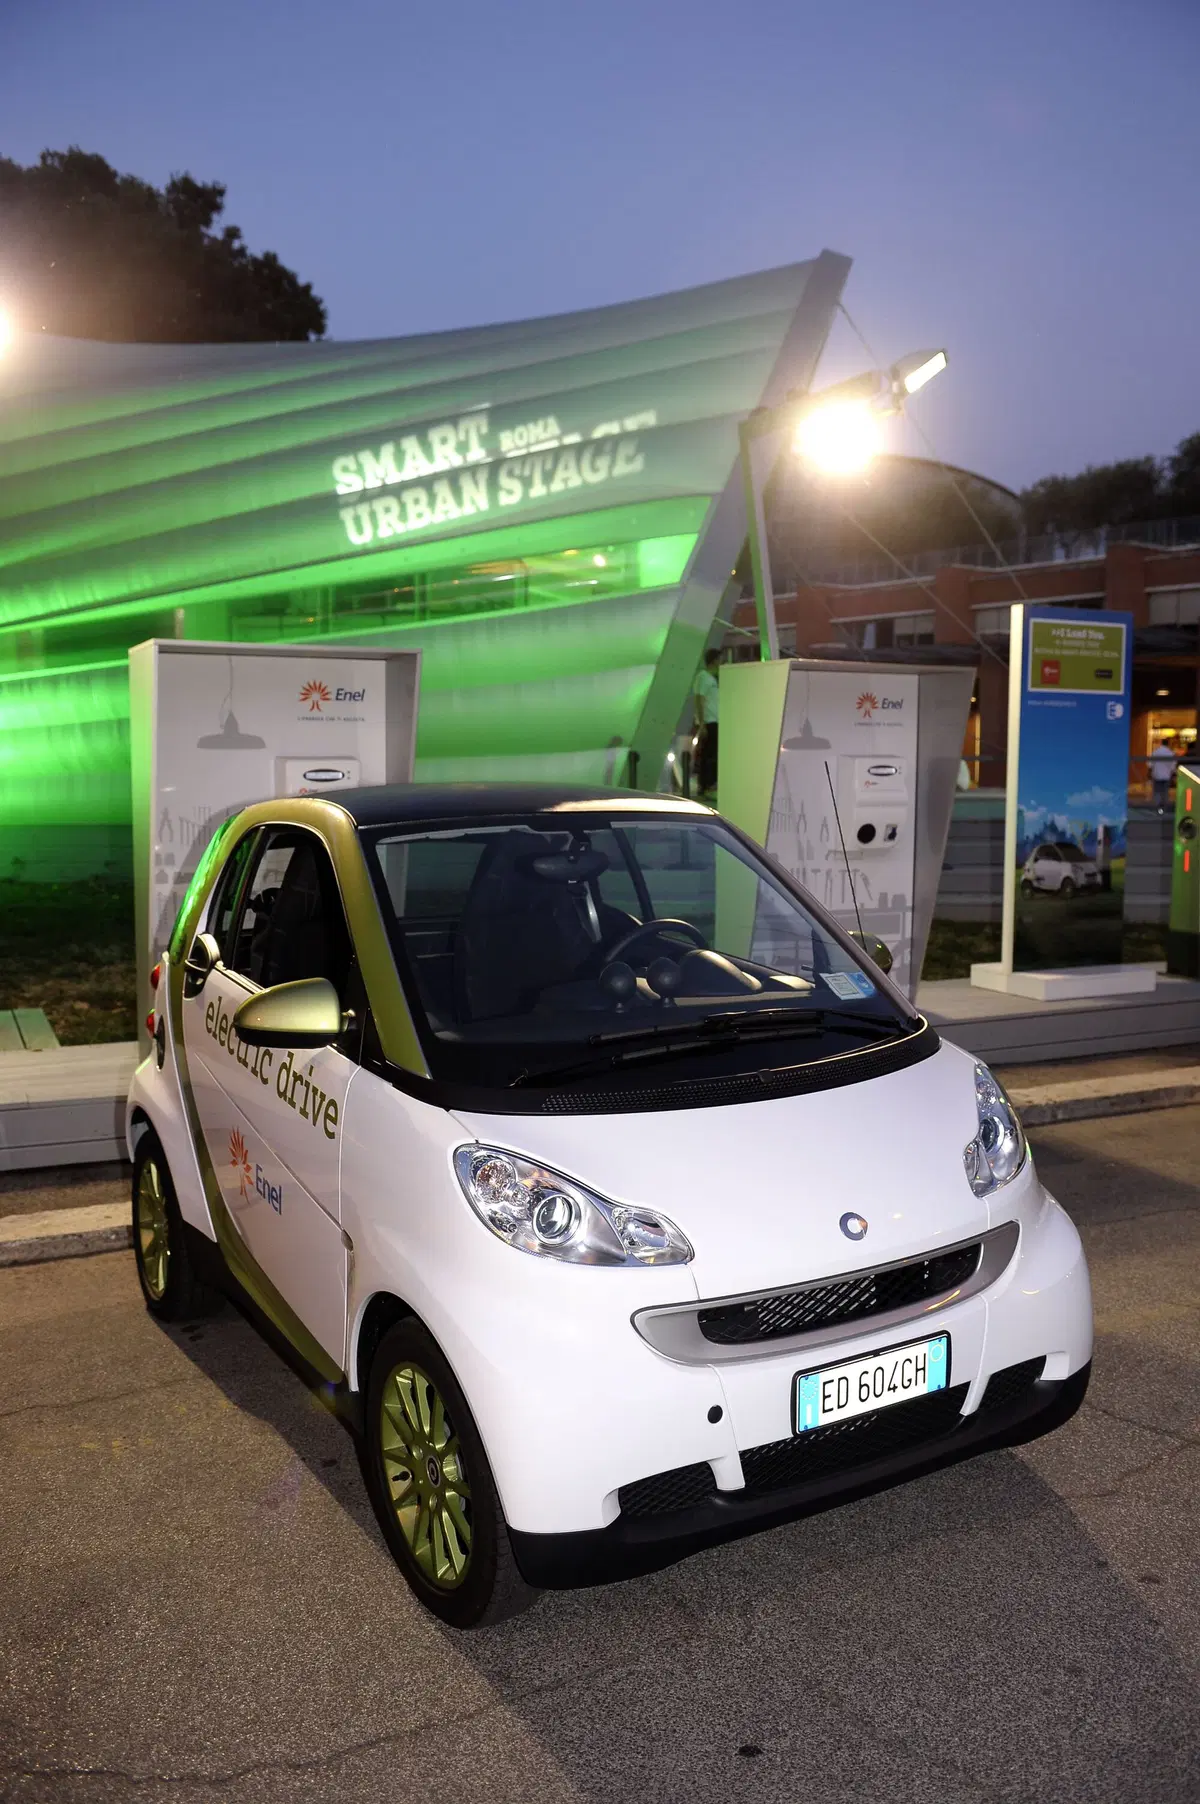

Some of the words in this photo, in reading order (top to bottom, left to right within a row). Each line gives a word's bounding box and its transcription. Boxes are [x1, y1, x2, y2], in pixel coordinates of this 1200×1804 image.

[332, 405, 490, 495] SMART
[499, 415, 560, 451] ROMA
[340, 465, 490, 545] URBAN
[499, 422, 652, 505] STAGE
[335, 688, 365, 701] Enel
[881, 698, 904, 710] Enel
[277, 1052, 338, 1139] drive
[255, 1164, 282, 1215] Enel
[822, 1376, 849, 1414] ED
[858, 1353, 927, 1402] 604GH
